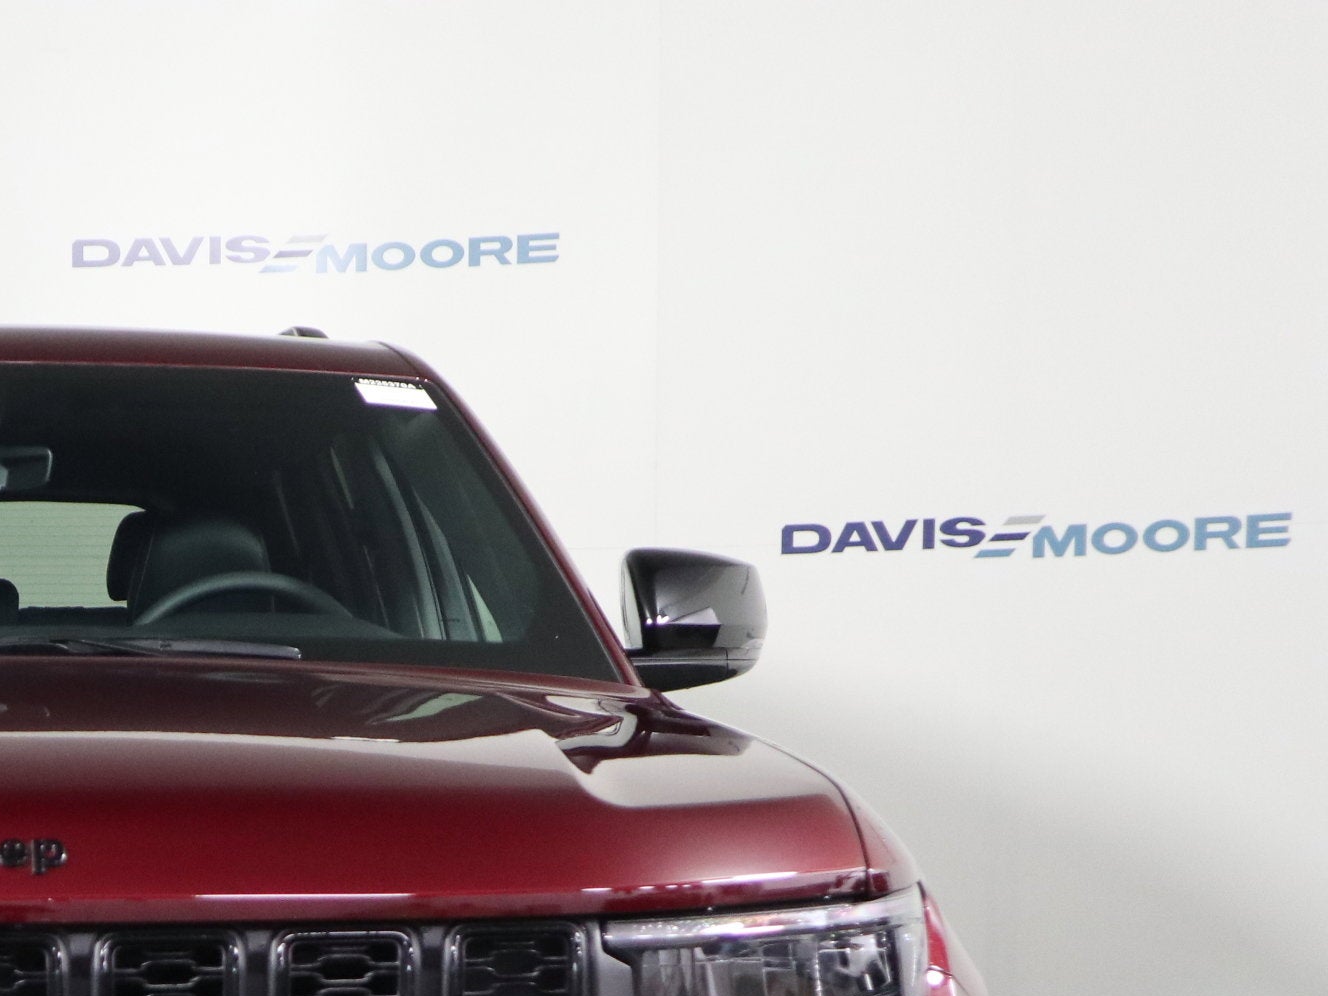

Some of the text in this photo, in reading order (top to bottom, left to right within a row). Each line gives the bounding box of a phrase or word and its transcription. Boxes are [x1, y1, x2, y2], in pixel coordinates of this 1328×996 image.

[71, 232, 560, 274] DAVIS MOORE
[780, 511, 1293, 559] DAVIS MOORE
